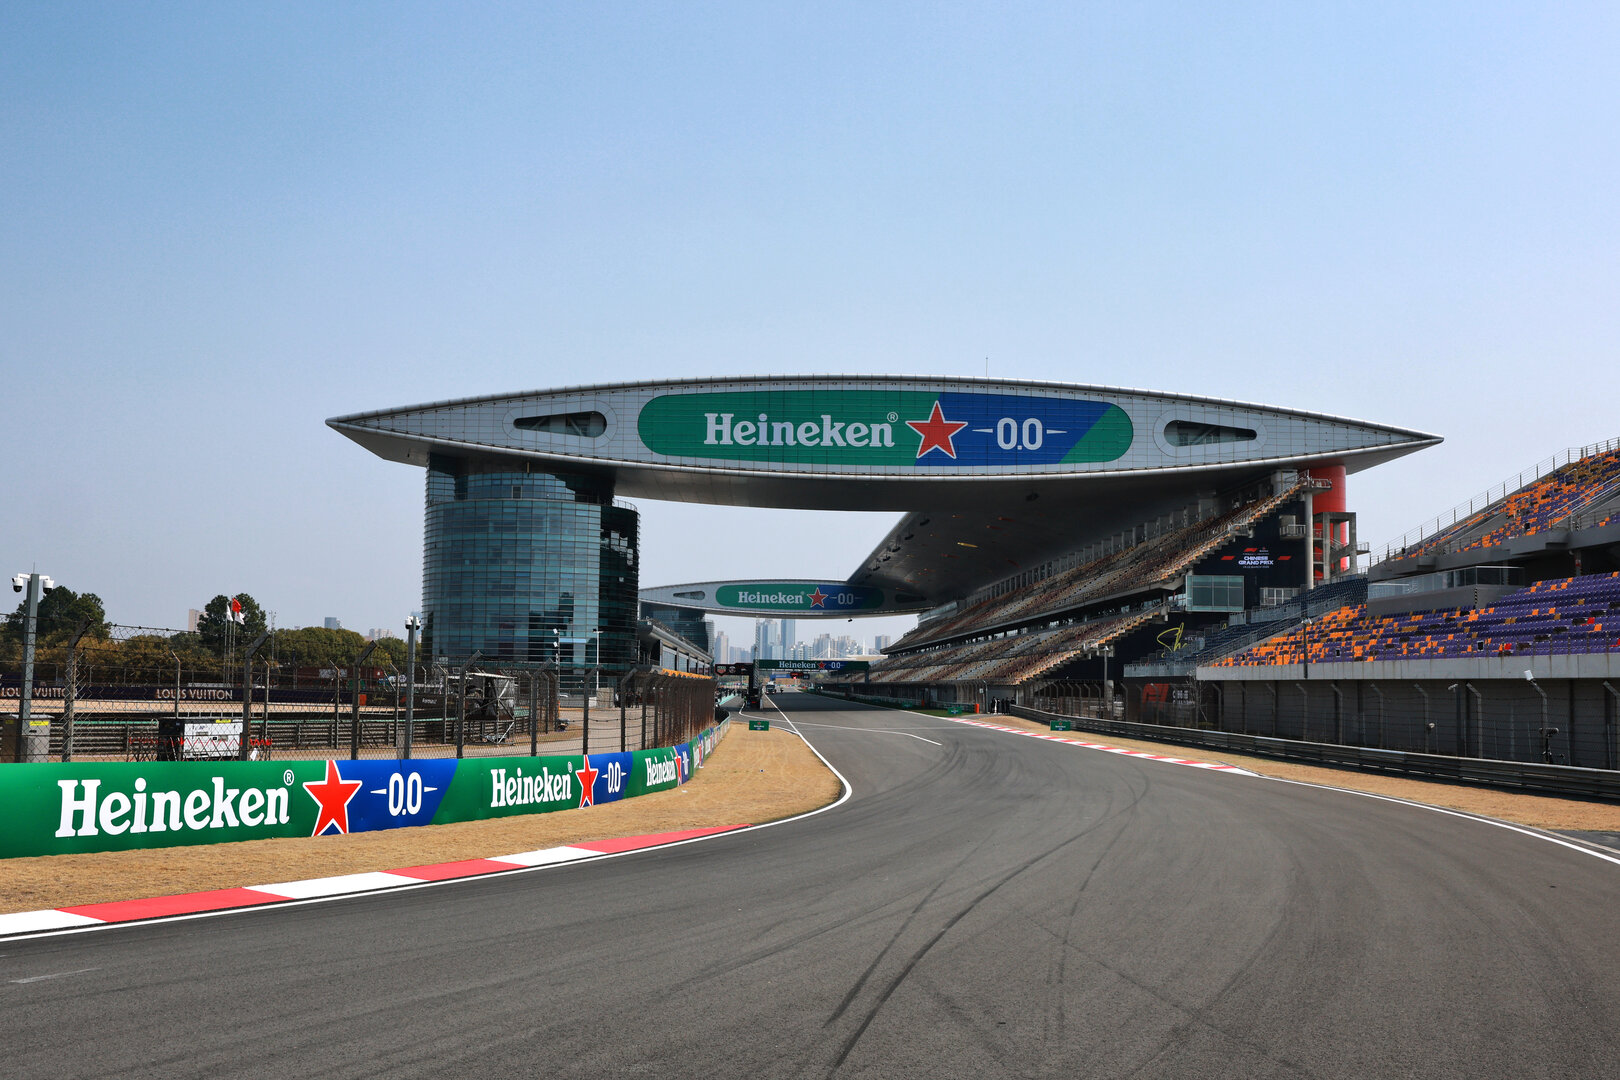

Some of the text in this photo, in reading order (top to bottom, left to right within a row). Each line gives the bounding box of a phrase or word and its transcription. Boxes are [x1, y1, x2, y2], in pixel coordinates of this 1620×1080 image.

[704, 412, 1043, 451] Heineken 0.0
[738, 591, 854, 606] Heineken 0.0
[779, 660, 816, 669] Heineken
[156, 688, 233, 700] LOUIS VUITTON
[490, 761, 621, 808] Heineken 0.0
[645, 755, 677, 787] Heineken
[55, 772, 422, 838] Heineken 0.0
